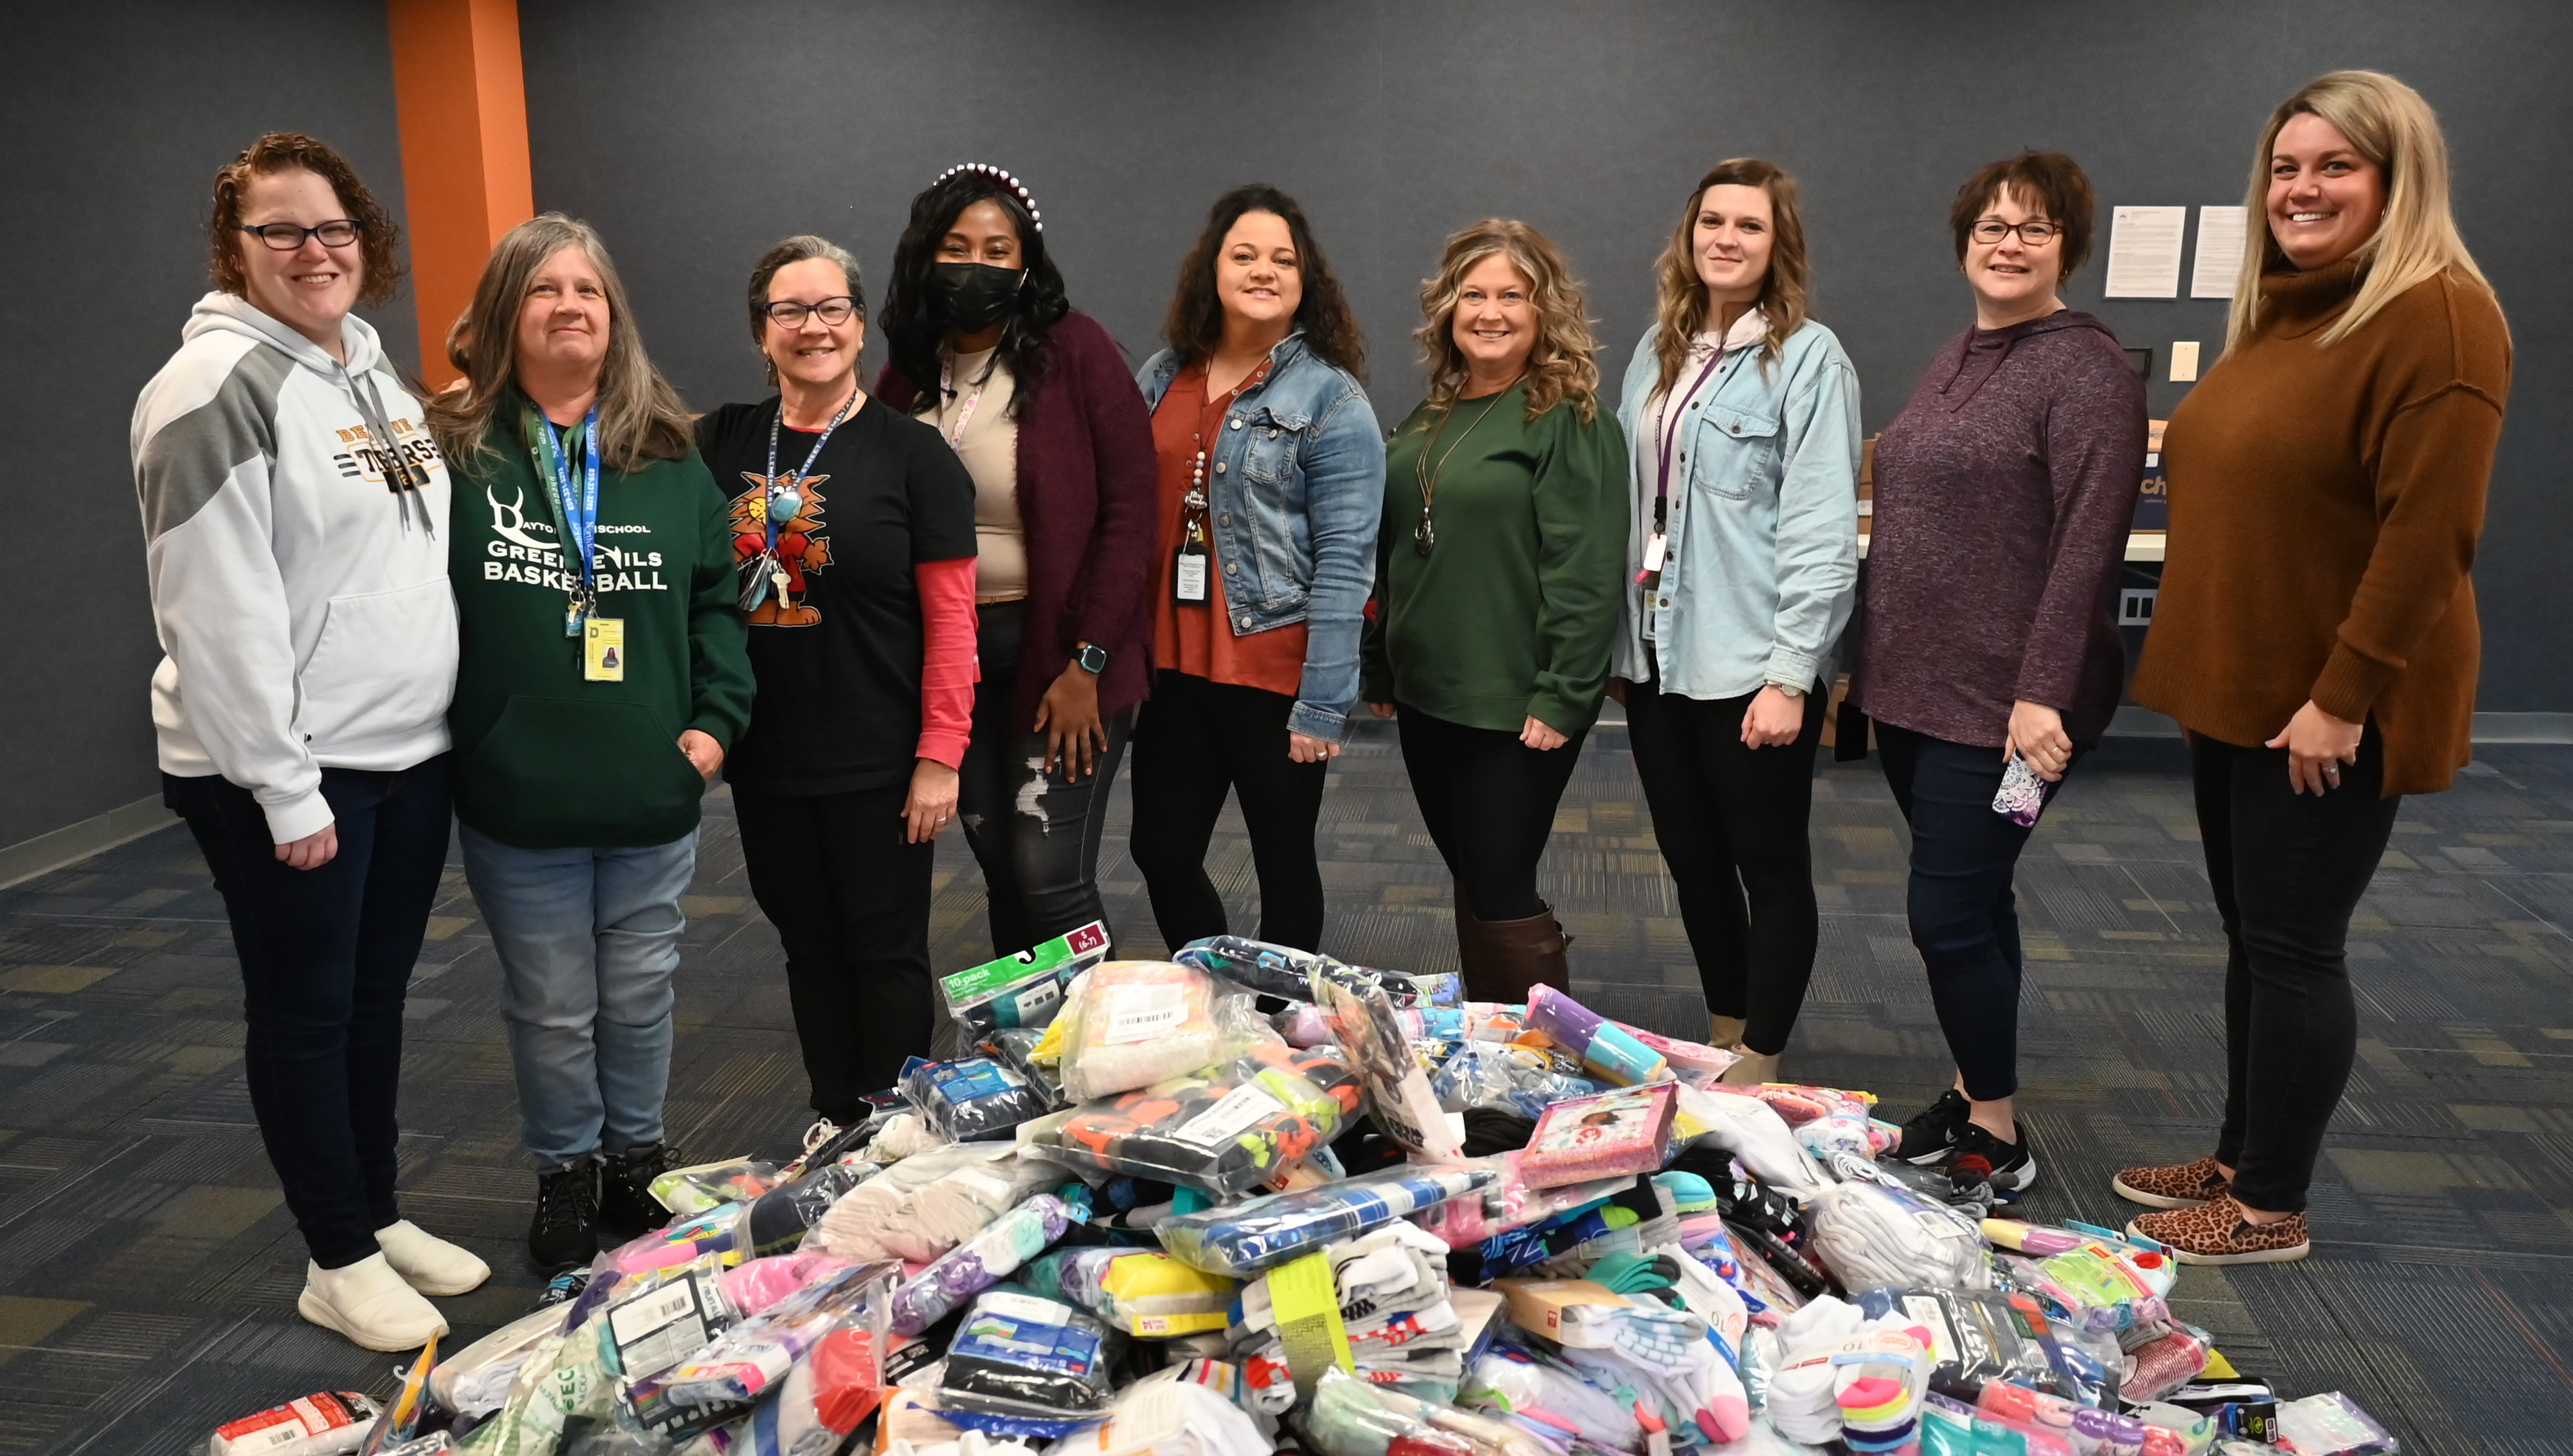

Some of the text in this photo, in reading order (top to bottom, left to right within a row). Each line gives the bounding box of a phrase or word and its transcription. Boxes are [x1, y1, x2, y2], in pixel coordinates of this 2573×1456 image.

[771, 418, 780, 446] STREET
[801, 444, 821, 473] STREET
[558, 467, 575, 511] 859-331-3292
[586, 468, 595, 510] 859-331-3292
[488, 541, 564, 568] GREE
[484, 561, 667, 592] BASKEBALL
[1079, 936, 1097, 950] (6-7)
